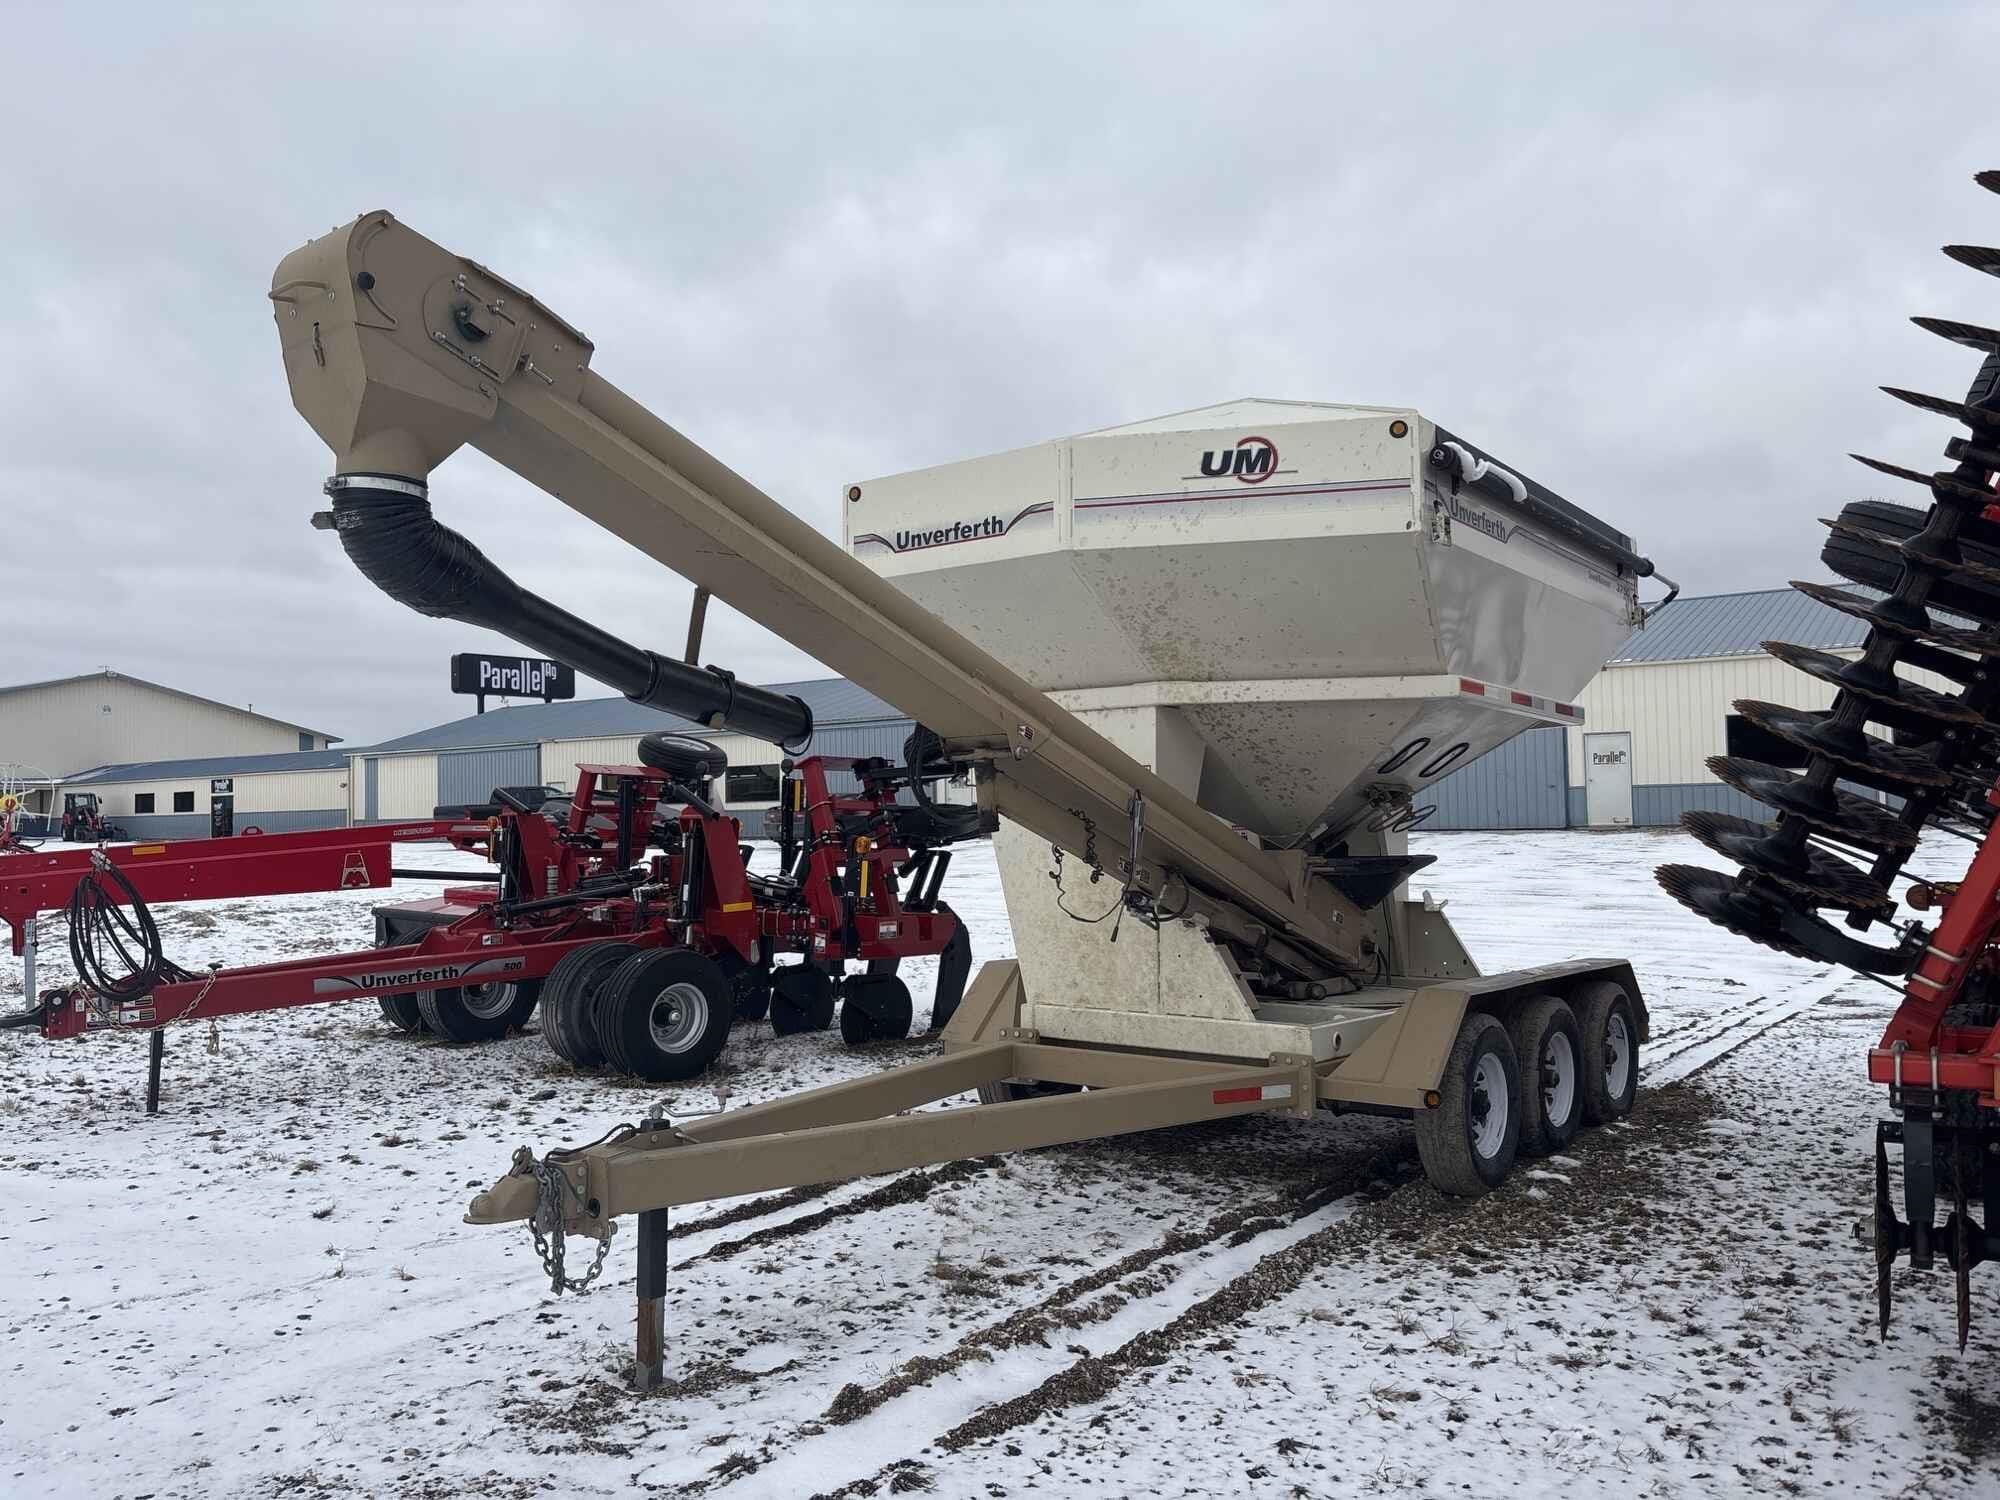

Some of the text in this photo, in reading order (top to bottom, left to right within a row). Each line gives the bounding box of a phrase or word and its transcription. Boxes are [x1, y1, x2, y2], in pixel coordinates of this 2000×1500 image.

[1200, 447, 1272, 476] UM
[896, 516, 1003, 549] Unverferth
[1450, 496, 1506, 541] Unverferth
[361, 967, 459, 987] Unverferth
[503, 962, 522, 970] 500
